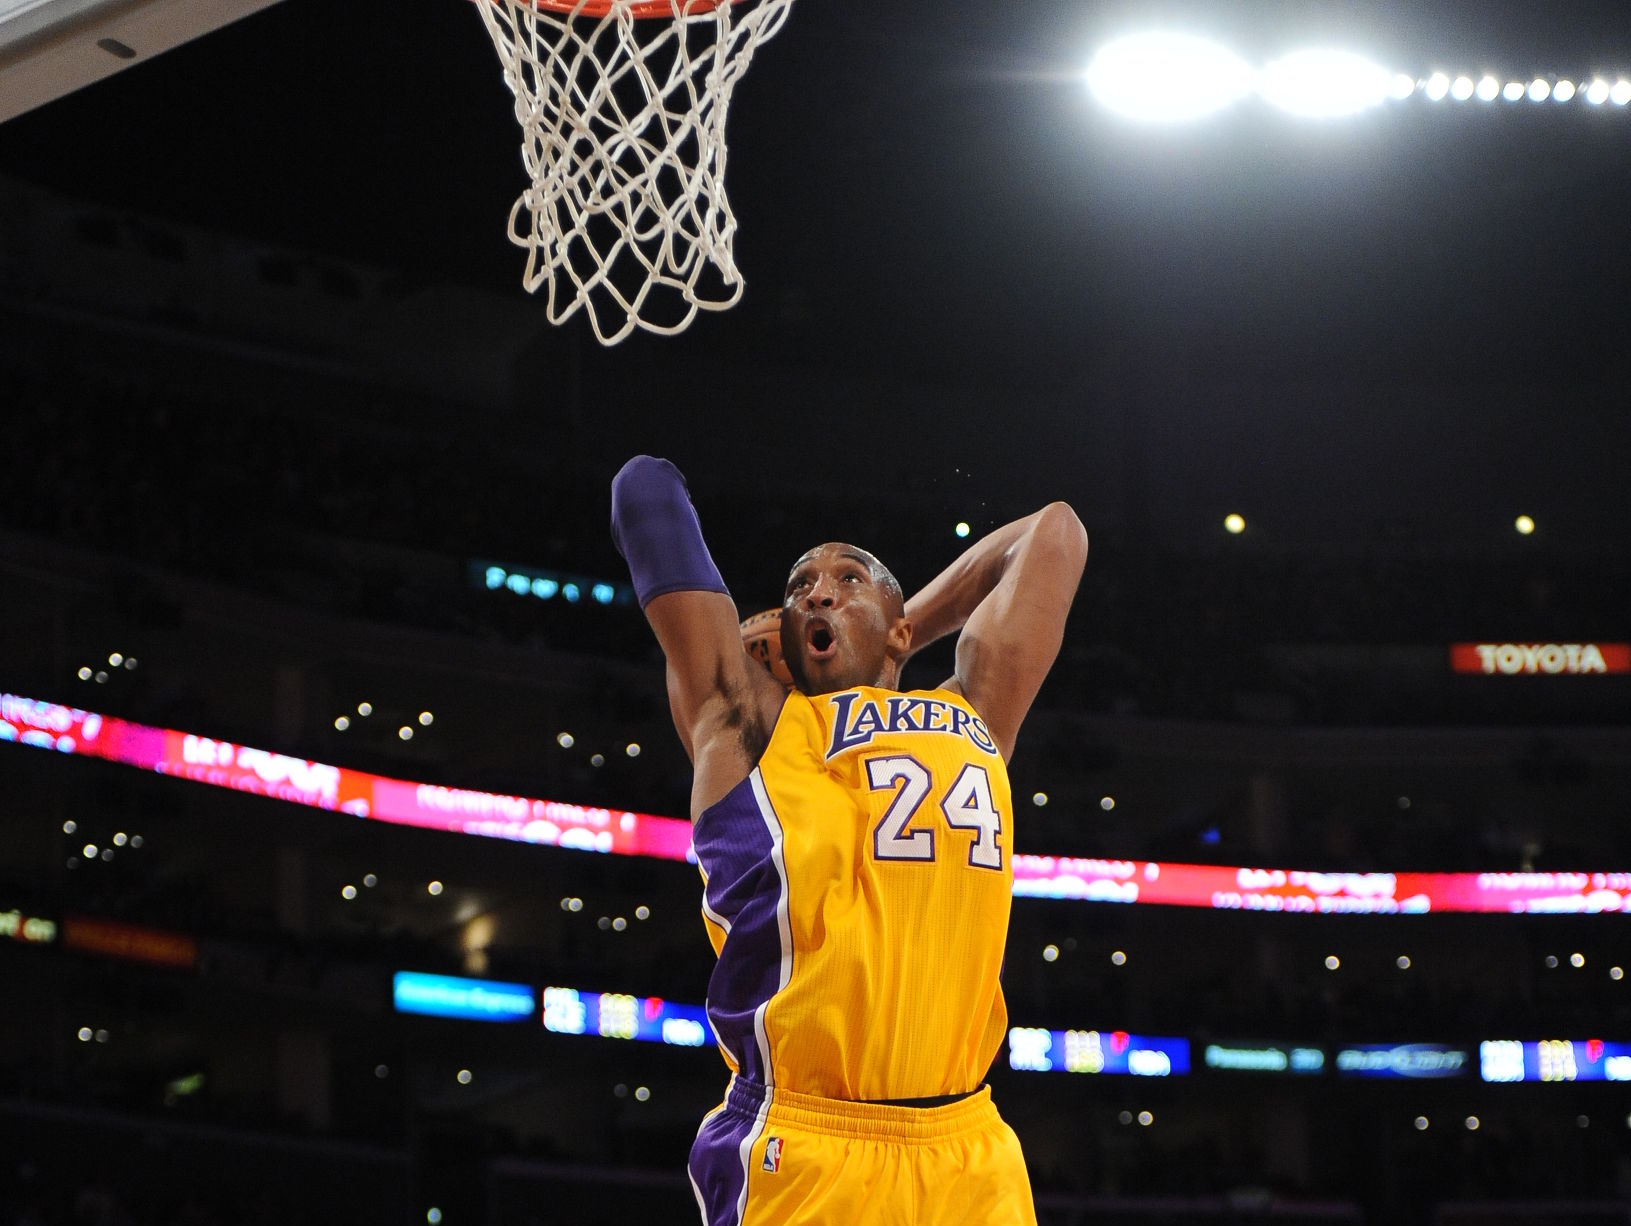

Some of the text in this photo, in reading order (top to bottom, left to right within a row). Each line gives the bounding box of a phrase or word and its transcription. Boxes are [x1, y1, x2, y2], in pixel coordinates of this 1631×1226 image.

[1475, 643, 1608, 674] TOYOTA
[825, 691, 998, 761] LAKERS
[864, 755, 1003, 871] 24
